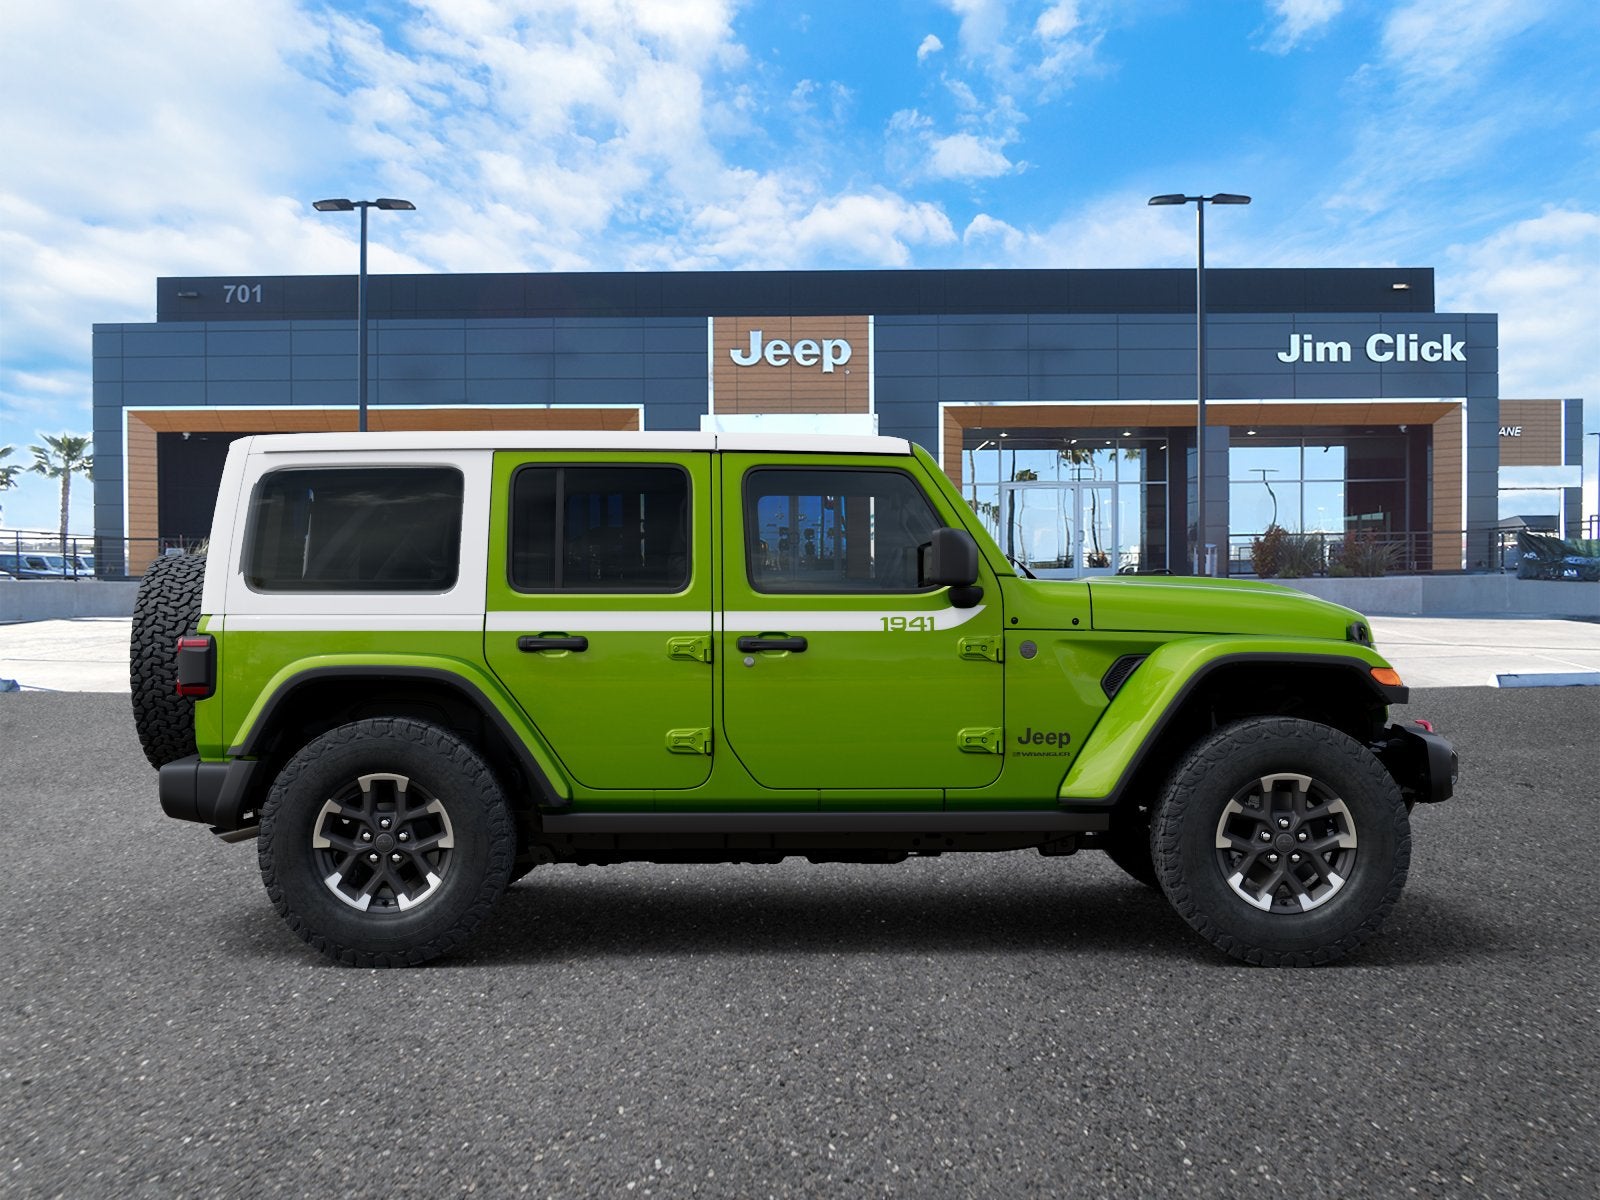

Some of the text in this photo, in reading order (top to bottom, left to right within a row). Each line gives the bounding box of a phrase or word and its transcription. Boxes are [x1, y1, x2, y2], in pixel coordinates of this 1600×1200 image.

[223, 284, 261, 303] 701
[729, 330, 852, 373] Jeep
[1277, 333, 1467, 362] Jim Click
[880, 616, 935, 632] 1941
[1017, 727, 1071, 748] Jeep
